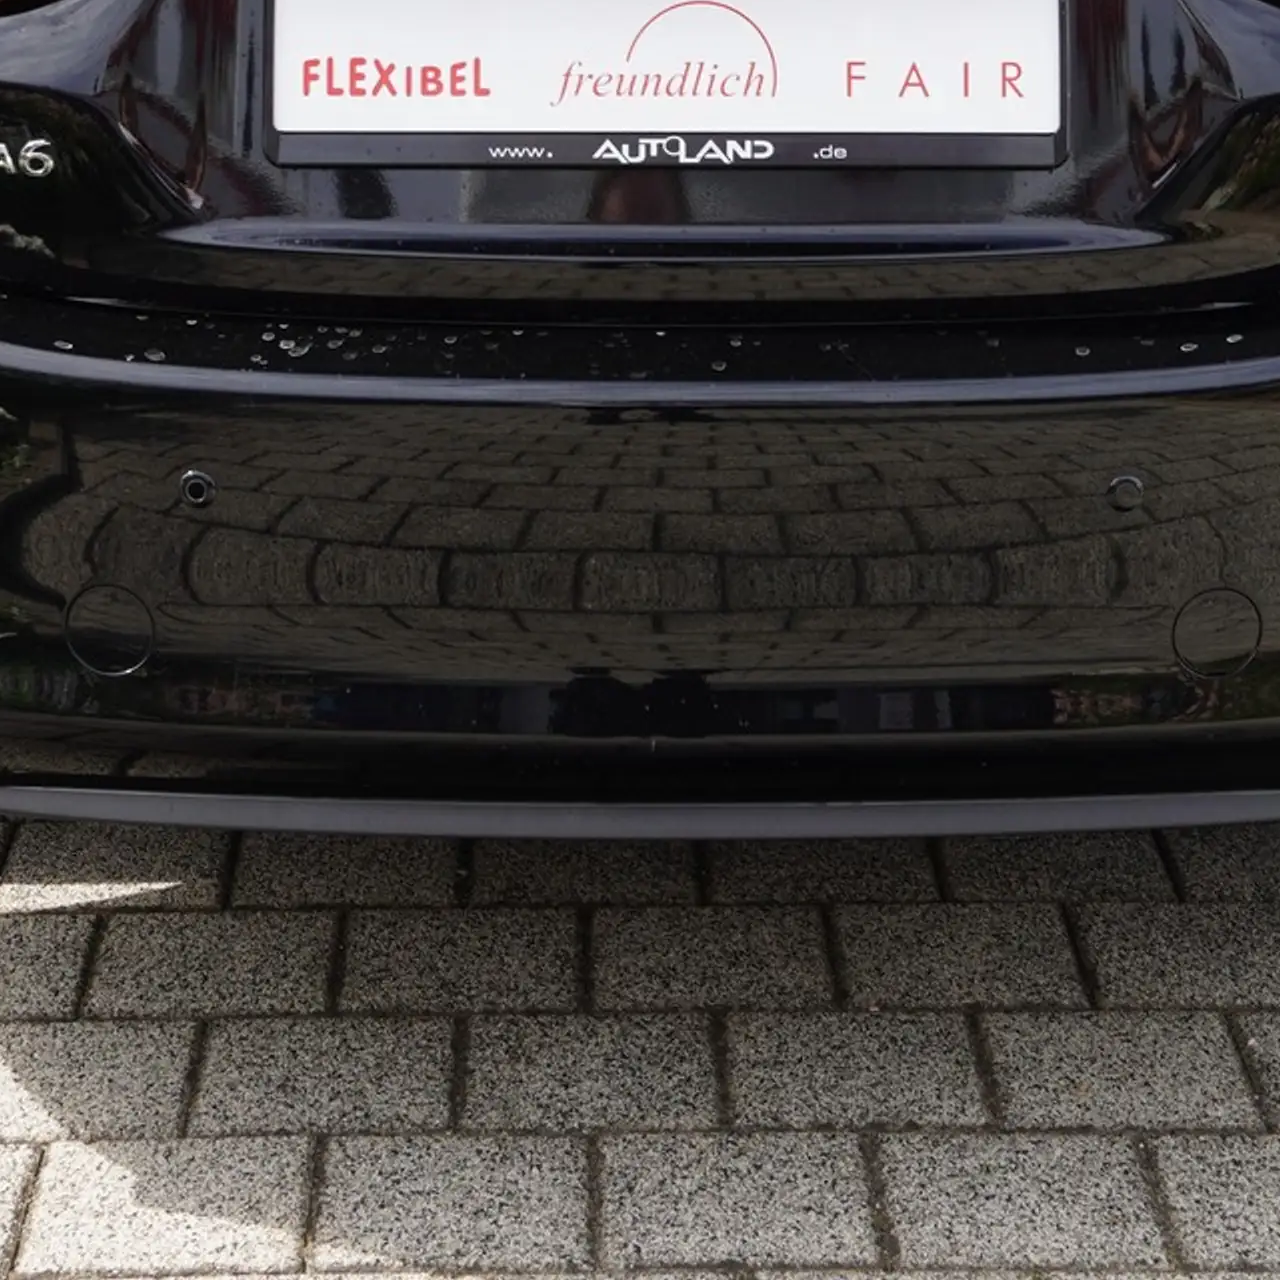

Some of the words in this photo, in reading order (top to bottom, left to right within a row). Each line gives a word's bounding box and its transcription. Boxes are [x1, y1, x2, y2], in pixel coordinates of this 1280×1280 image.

[302, 57, 491, 97] FLEXIBEL
[550, 60, 765, 108] freundlich
[845, 61, 1025, 98] FAIR
